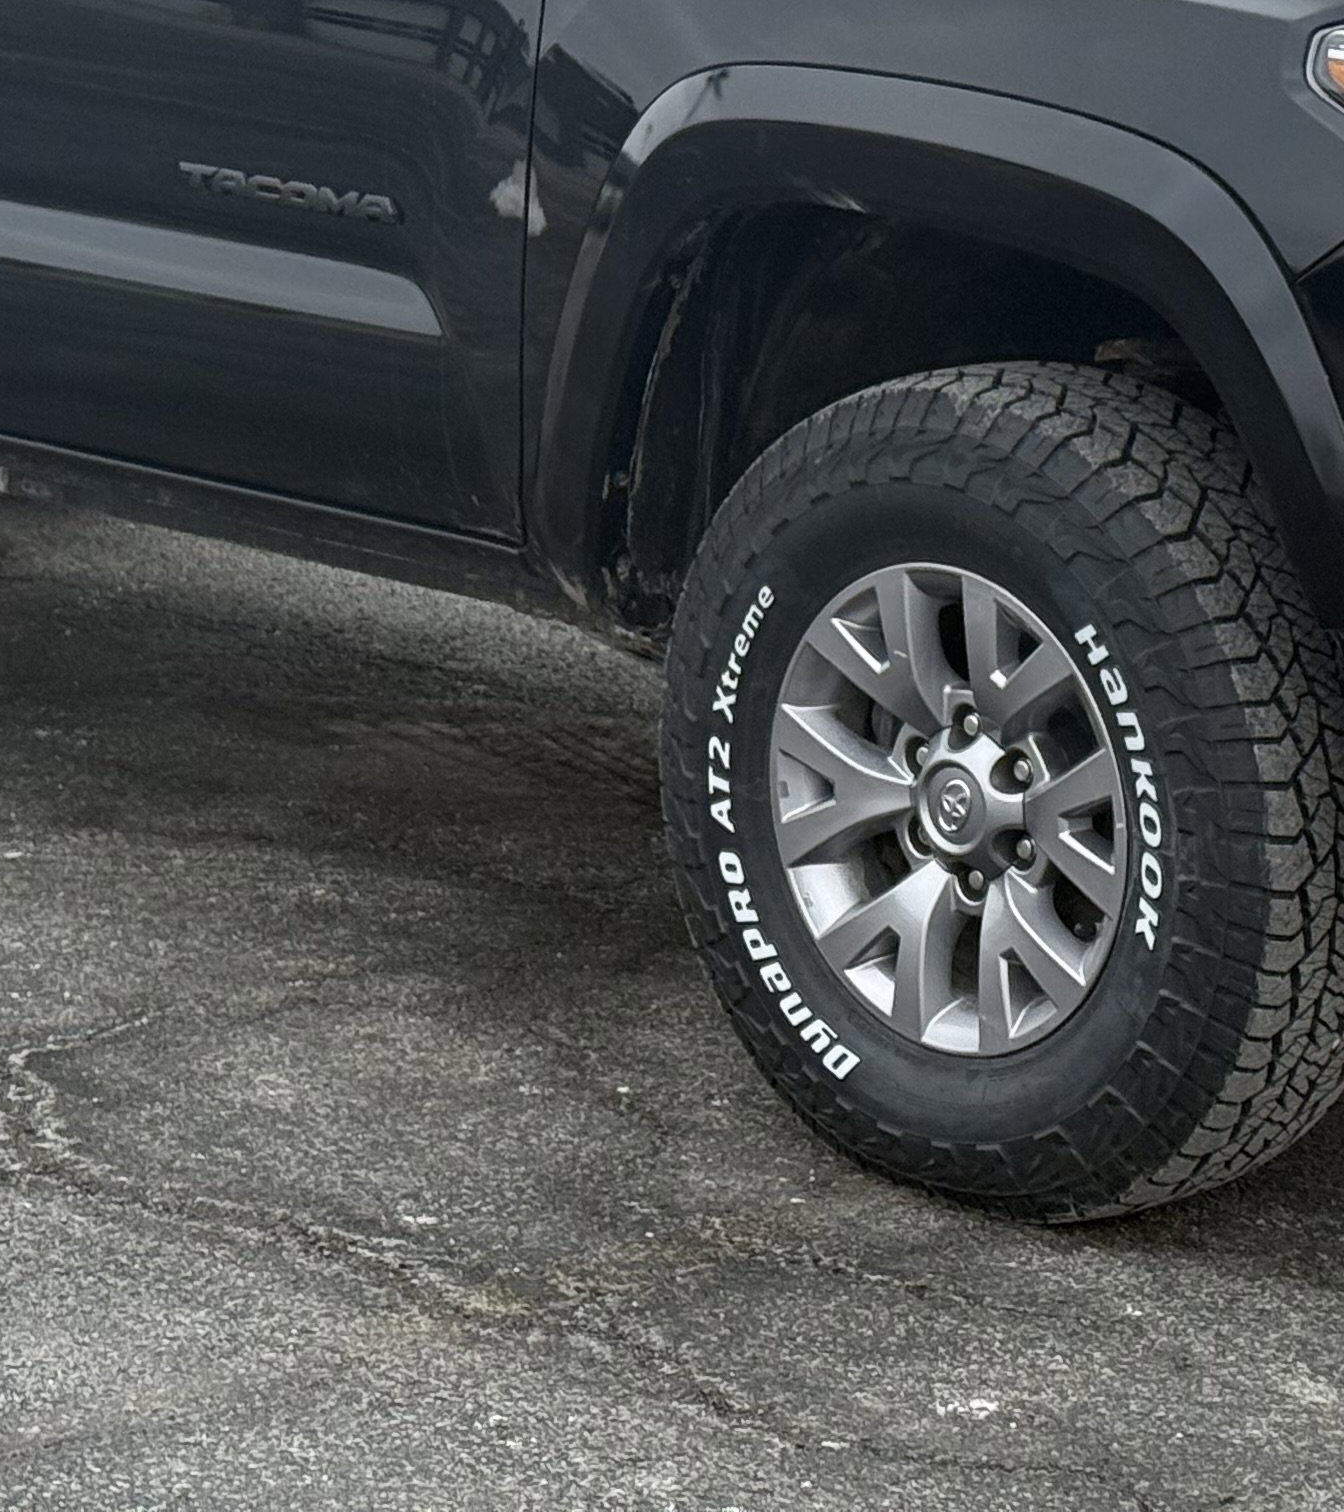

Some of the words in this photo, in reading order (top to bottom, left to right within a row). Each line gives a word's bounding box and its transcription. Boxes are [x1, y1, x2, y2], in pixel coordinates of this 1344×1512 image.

[179, 161, 399, 223] TACOMA
[712, 585, 775, 723] Xtreme
[708, 736, 736, 833] AT2
